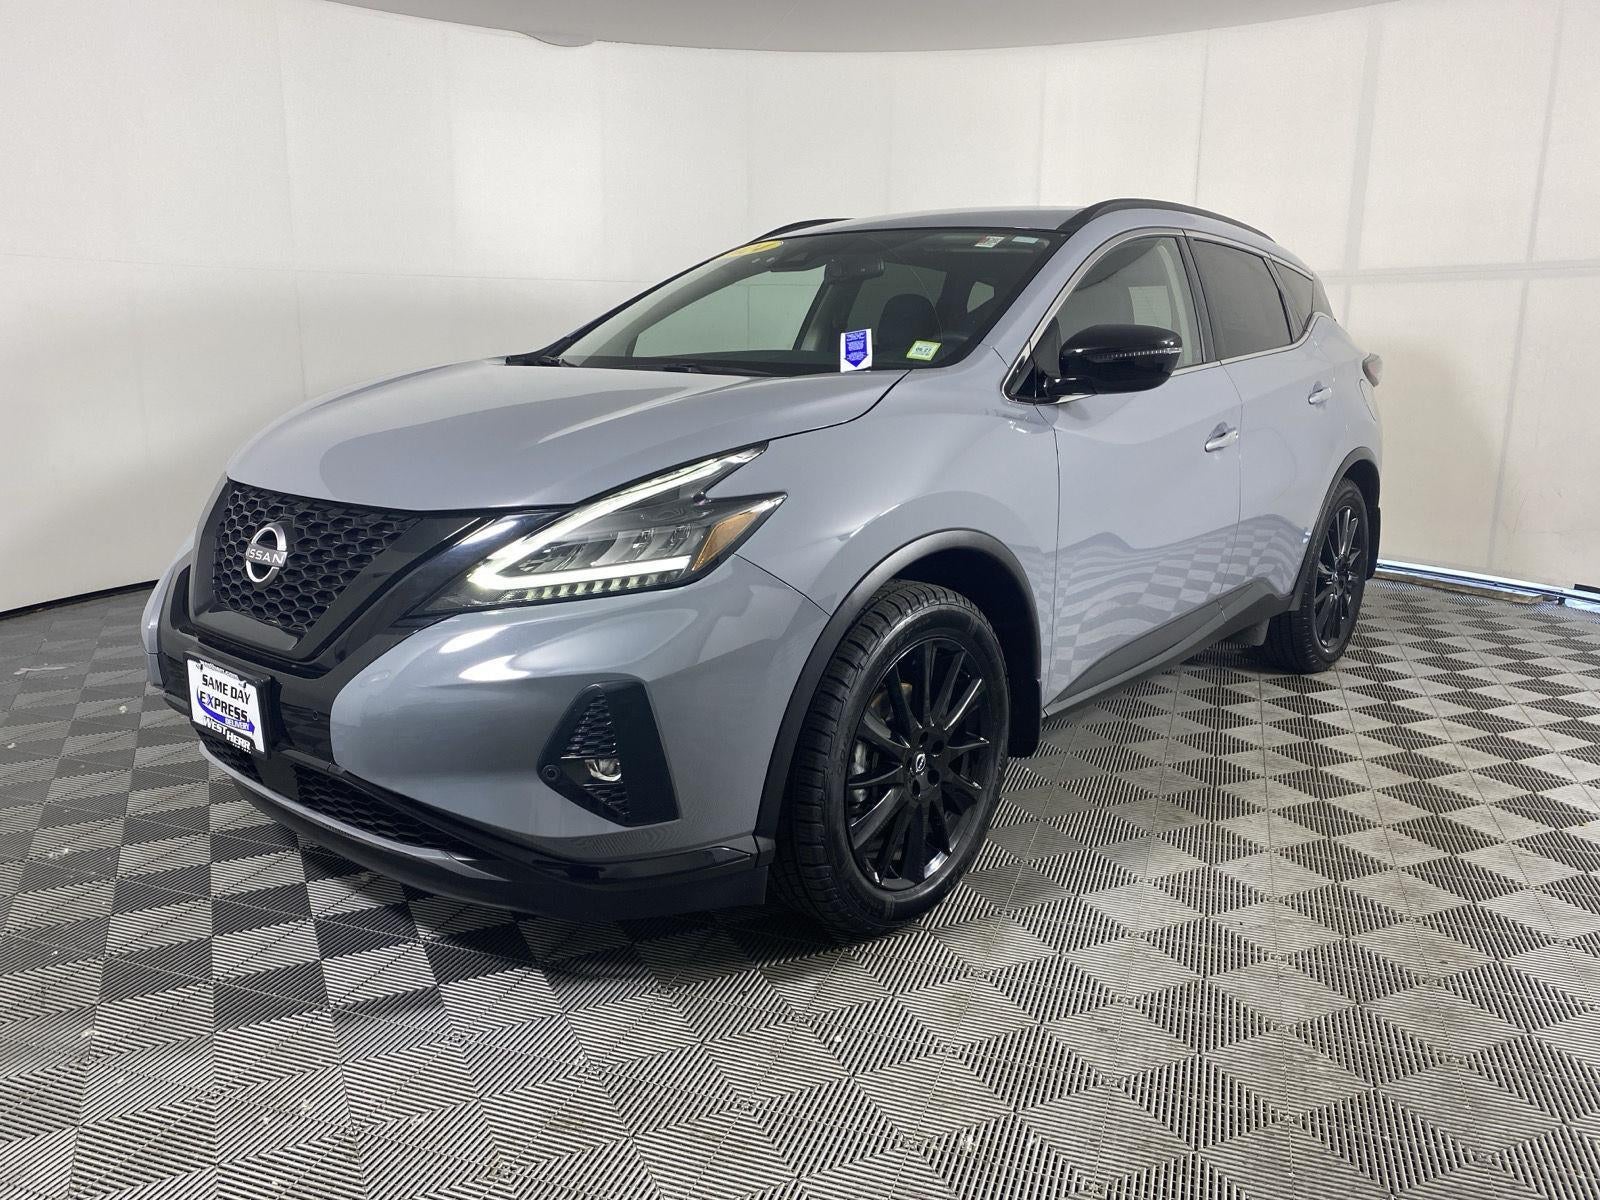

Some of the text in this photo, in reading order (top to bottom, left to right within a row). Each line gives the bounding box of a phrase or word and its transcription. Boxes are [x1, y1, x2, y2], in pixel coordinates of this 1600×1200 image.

[202, 674, 251, 705] SAME DAY
[200, 691, 248, 722] EXPRESS
